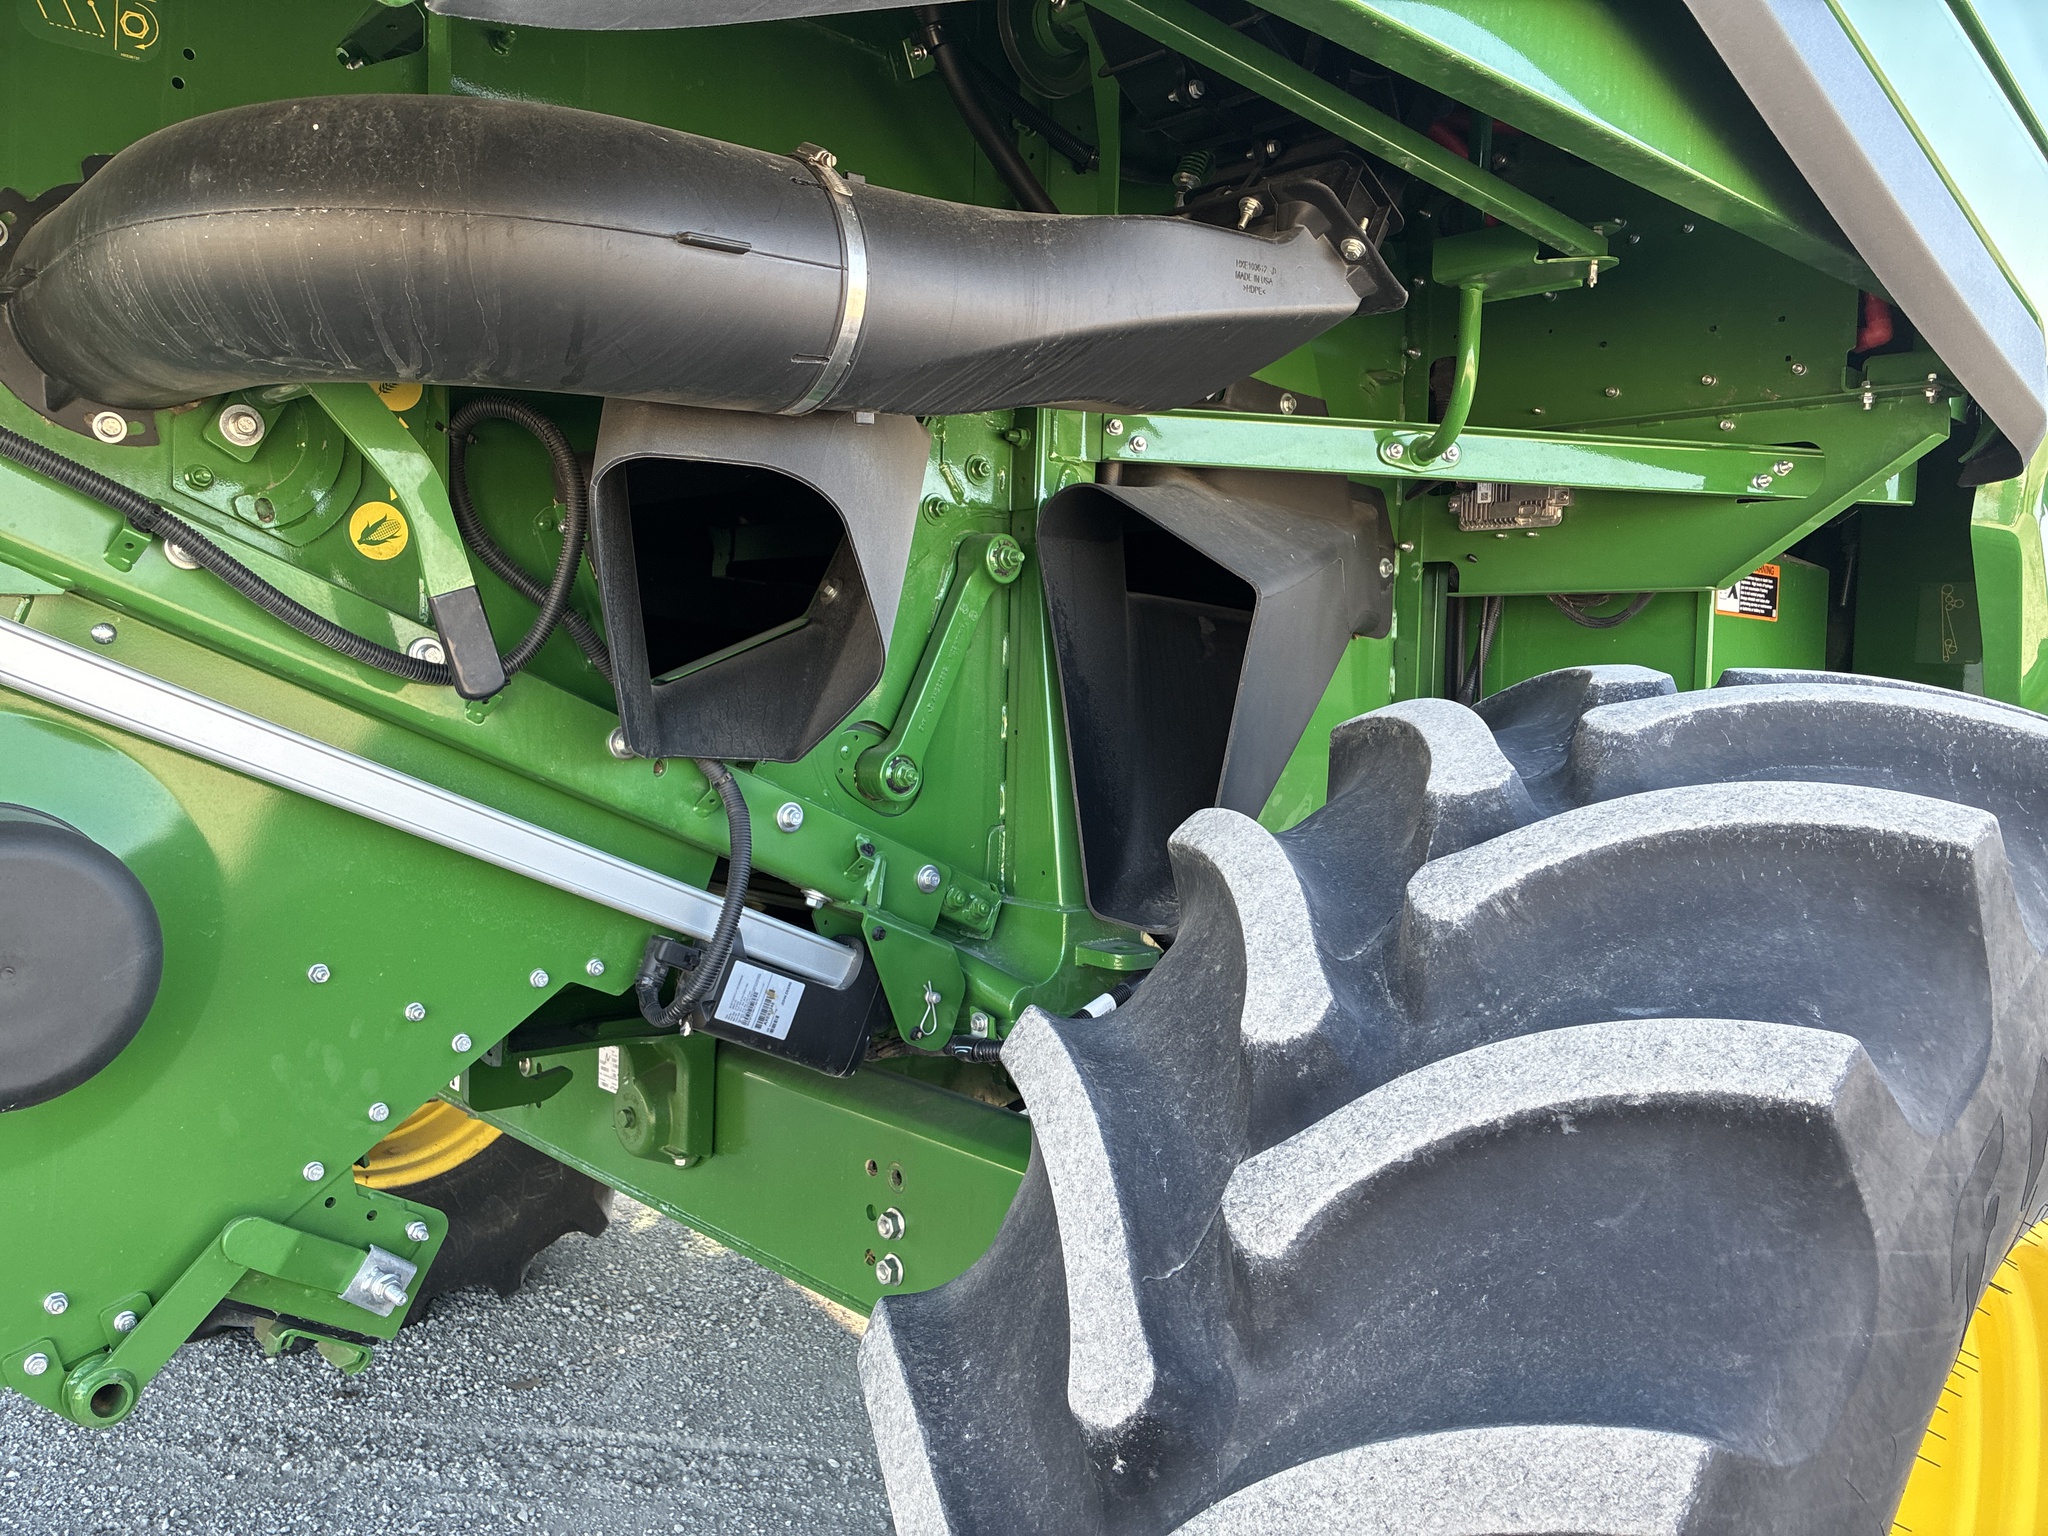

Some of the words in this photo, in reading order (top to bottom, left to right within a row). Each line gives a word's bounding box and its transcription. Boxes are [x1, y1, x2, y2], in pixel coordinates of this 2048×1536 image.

[1235, 270, 1252, 282] MADE
[1253, 274, 1260, 283] IN
[1260, 275, 1274, 286] USA
